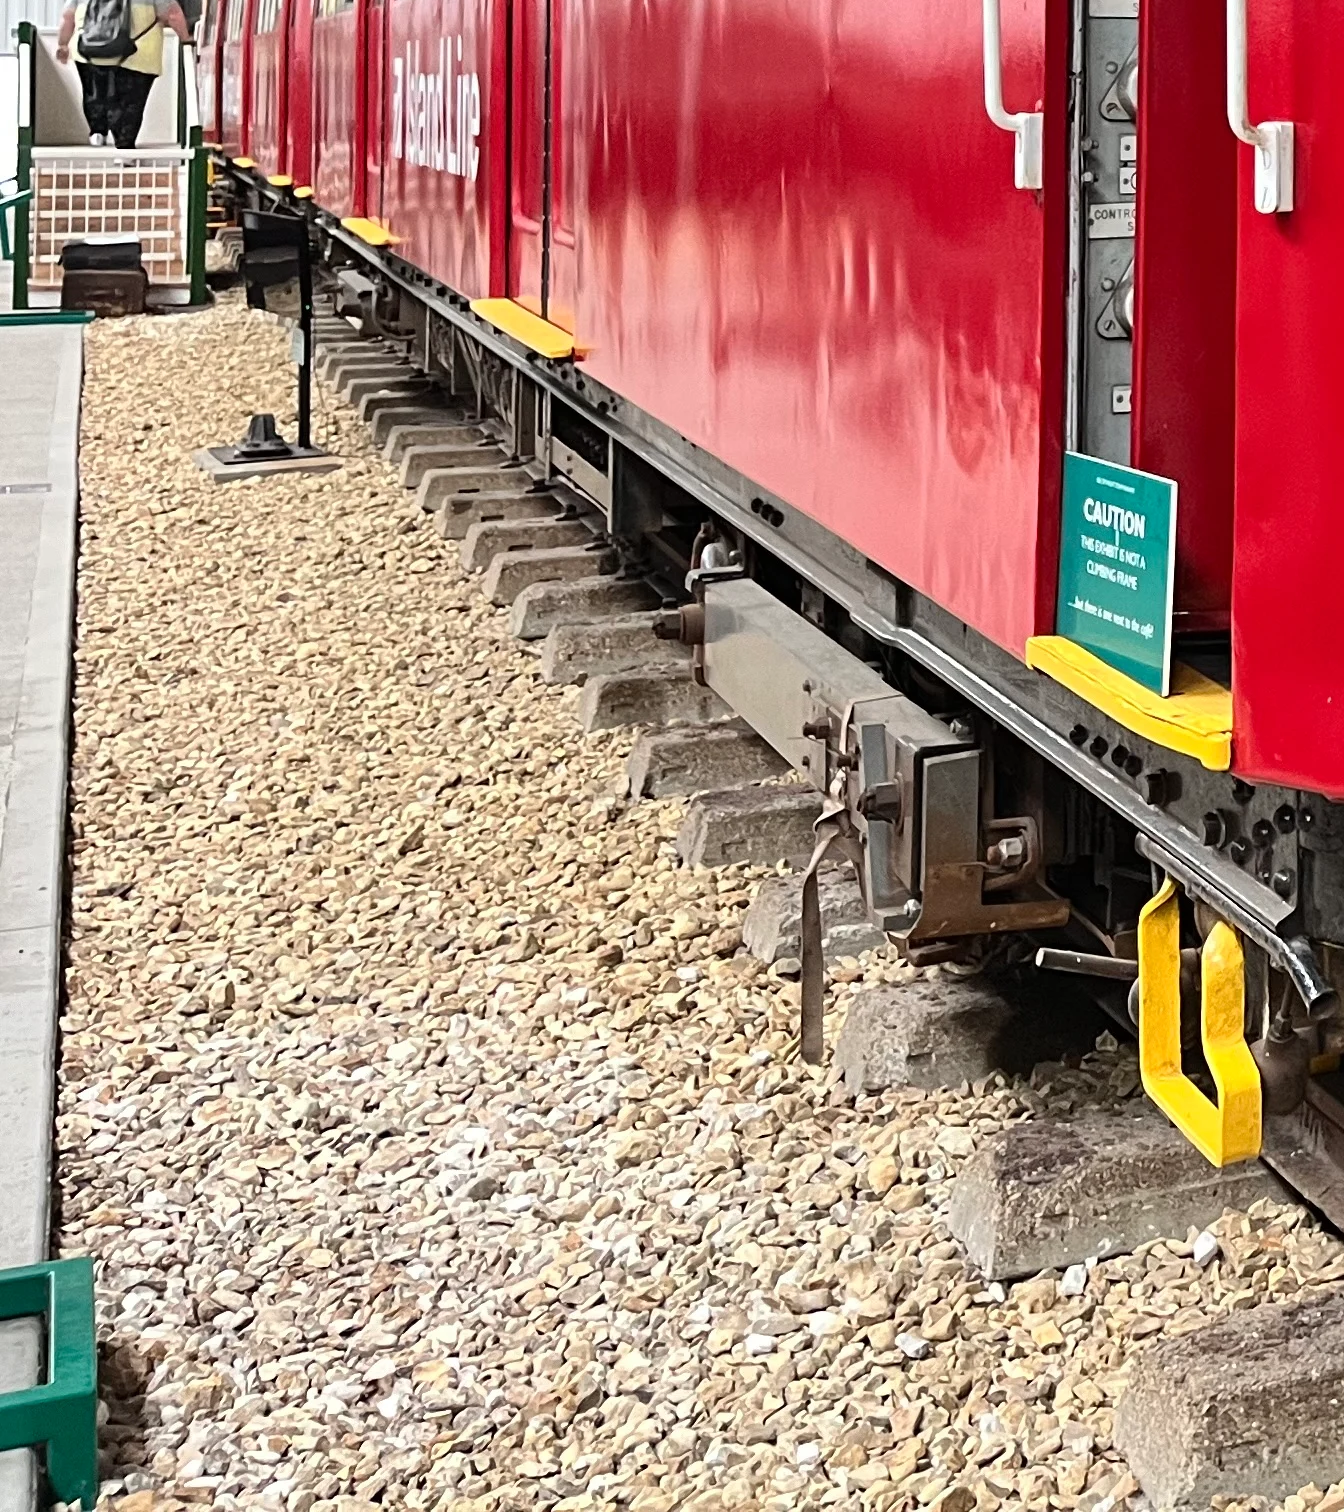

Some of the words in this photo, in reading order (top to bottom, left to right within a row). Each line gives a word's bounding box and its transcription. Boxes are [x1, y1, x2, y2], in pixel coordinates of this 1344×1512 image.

[406, 36, 444, 172] Island
[447, 34, 481, 182] Line
[1083, 497, 1145, 538] CAUTION
[1080, 534, 1094, 551] THIS
[1094, 539, 1118, 559] EXHIBIT
[1119, 547, 1125, 562] IS
[1125, 550, 1139, 568] NOT
[1140, 555, 1146, 570] A
[1086, 559, 1116, 582] CLIMBING
[1116, 570, 1137, 590] FRAME
